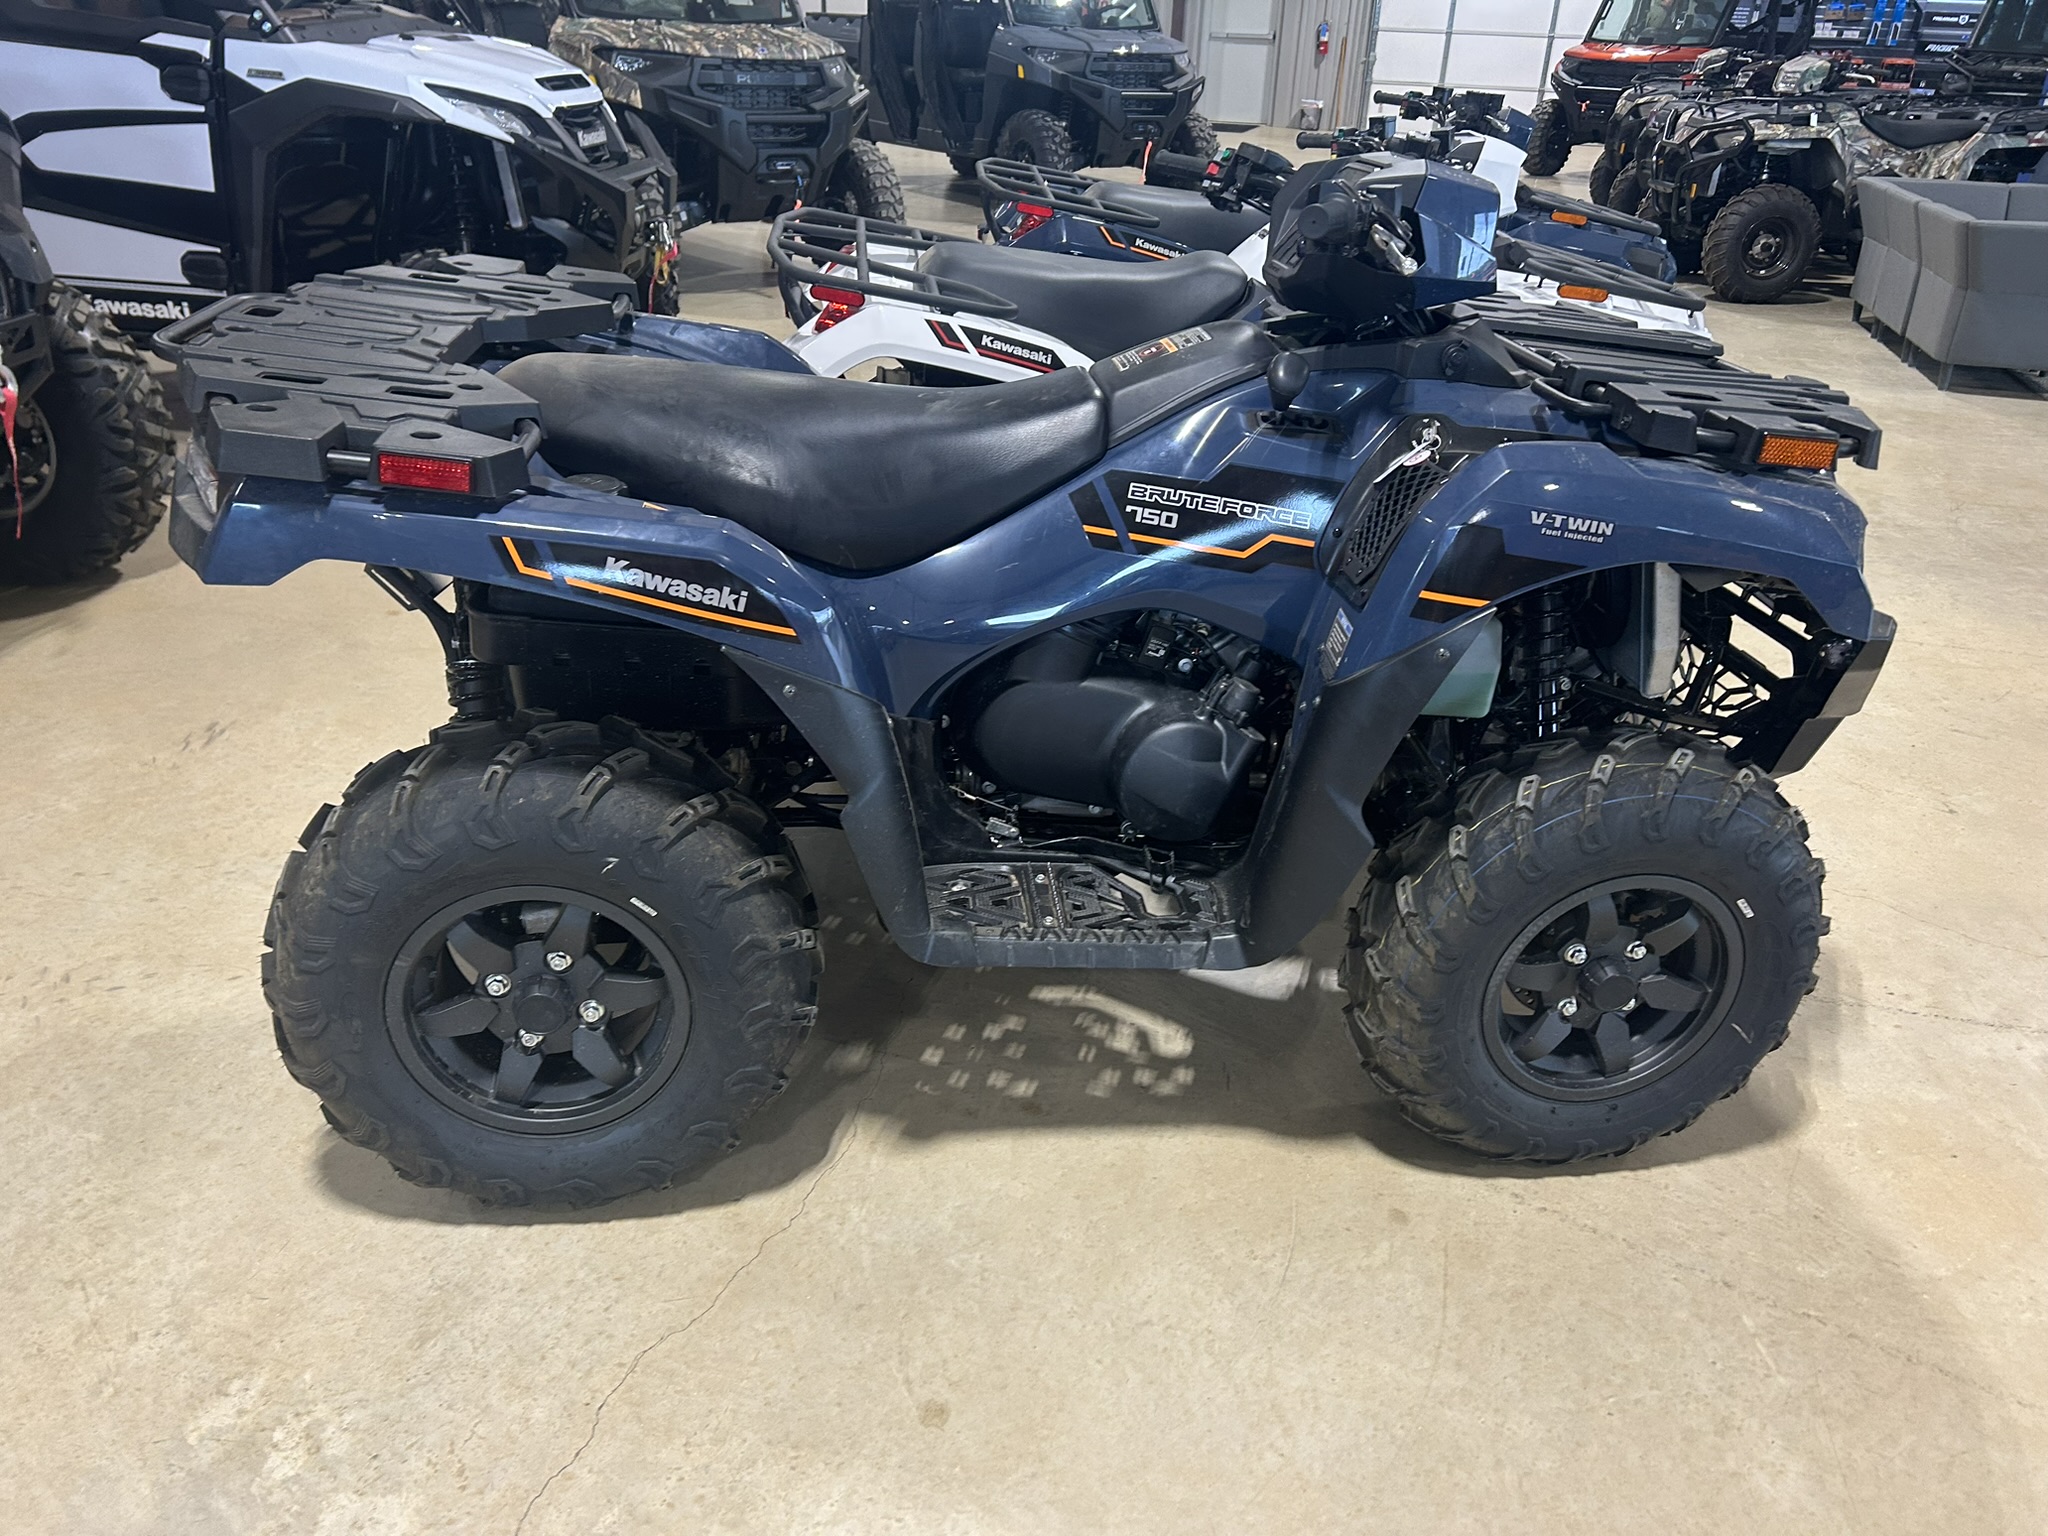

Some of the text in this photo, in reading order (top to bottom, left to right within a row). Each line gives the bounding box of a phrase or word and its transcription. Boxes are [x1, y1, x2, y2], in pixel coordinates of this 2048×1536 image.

[1135, 238, 1186, 258] Kawasak
[84, 294, 190, 319] awasaki
[981, 334, 1053, 365] Kawasaki
[1125, 505, 1179, 529] 750
[1530, 510, 1615, 536] V-TWIN
[1541, 527, 1605, 543] Fuel Injected
[602, 556, 749, 613] Kawasaki
